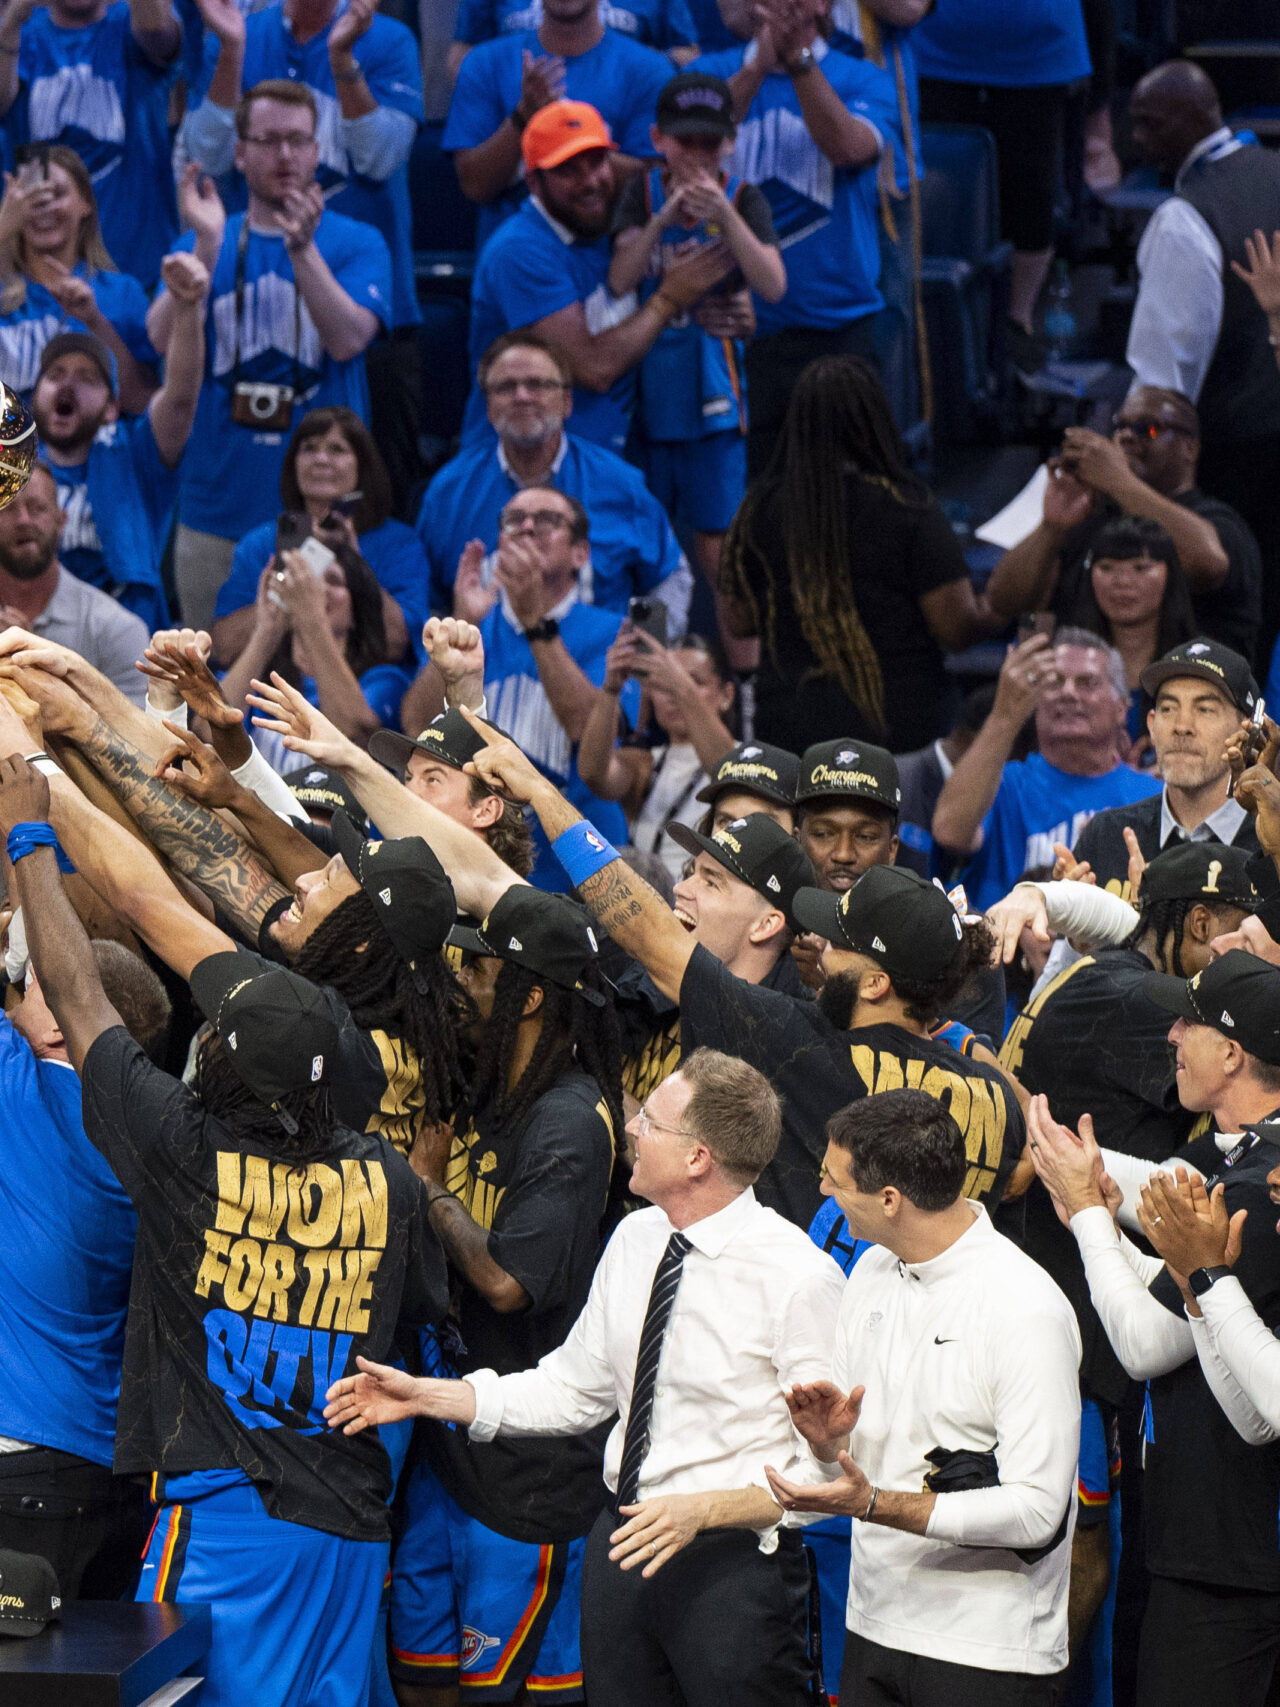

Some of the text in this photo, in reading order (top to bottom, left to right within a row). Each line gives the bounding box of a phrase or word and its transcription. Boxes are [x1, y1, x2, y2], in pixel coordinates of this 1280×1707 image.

[811, 764, 879, 788] Champions
[215, 1150, 388, 1249] WON
[194, 1228, 384, 1334] FOR THE
[202, 1308, 355, 1437] CITY
